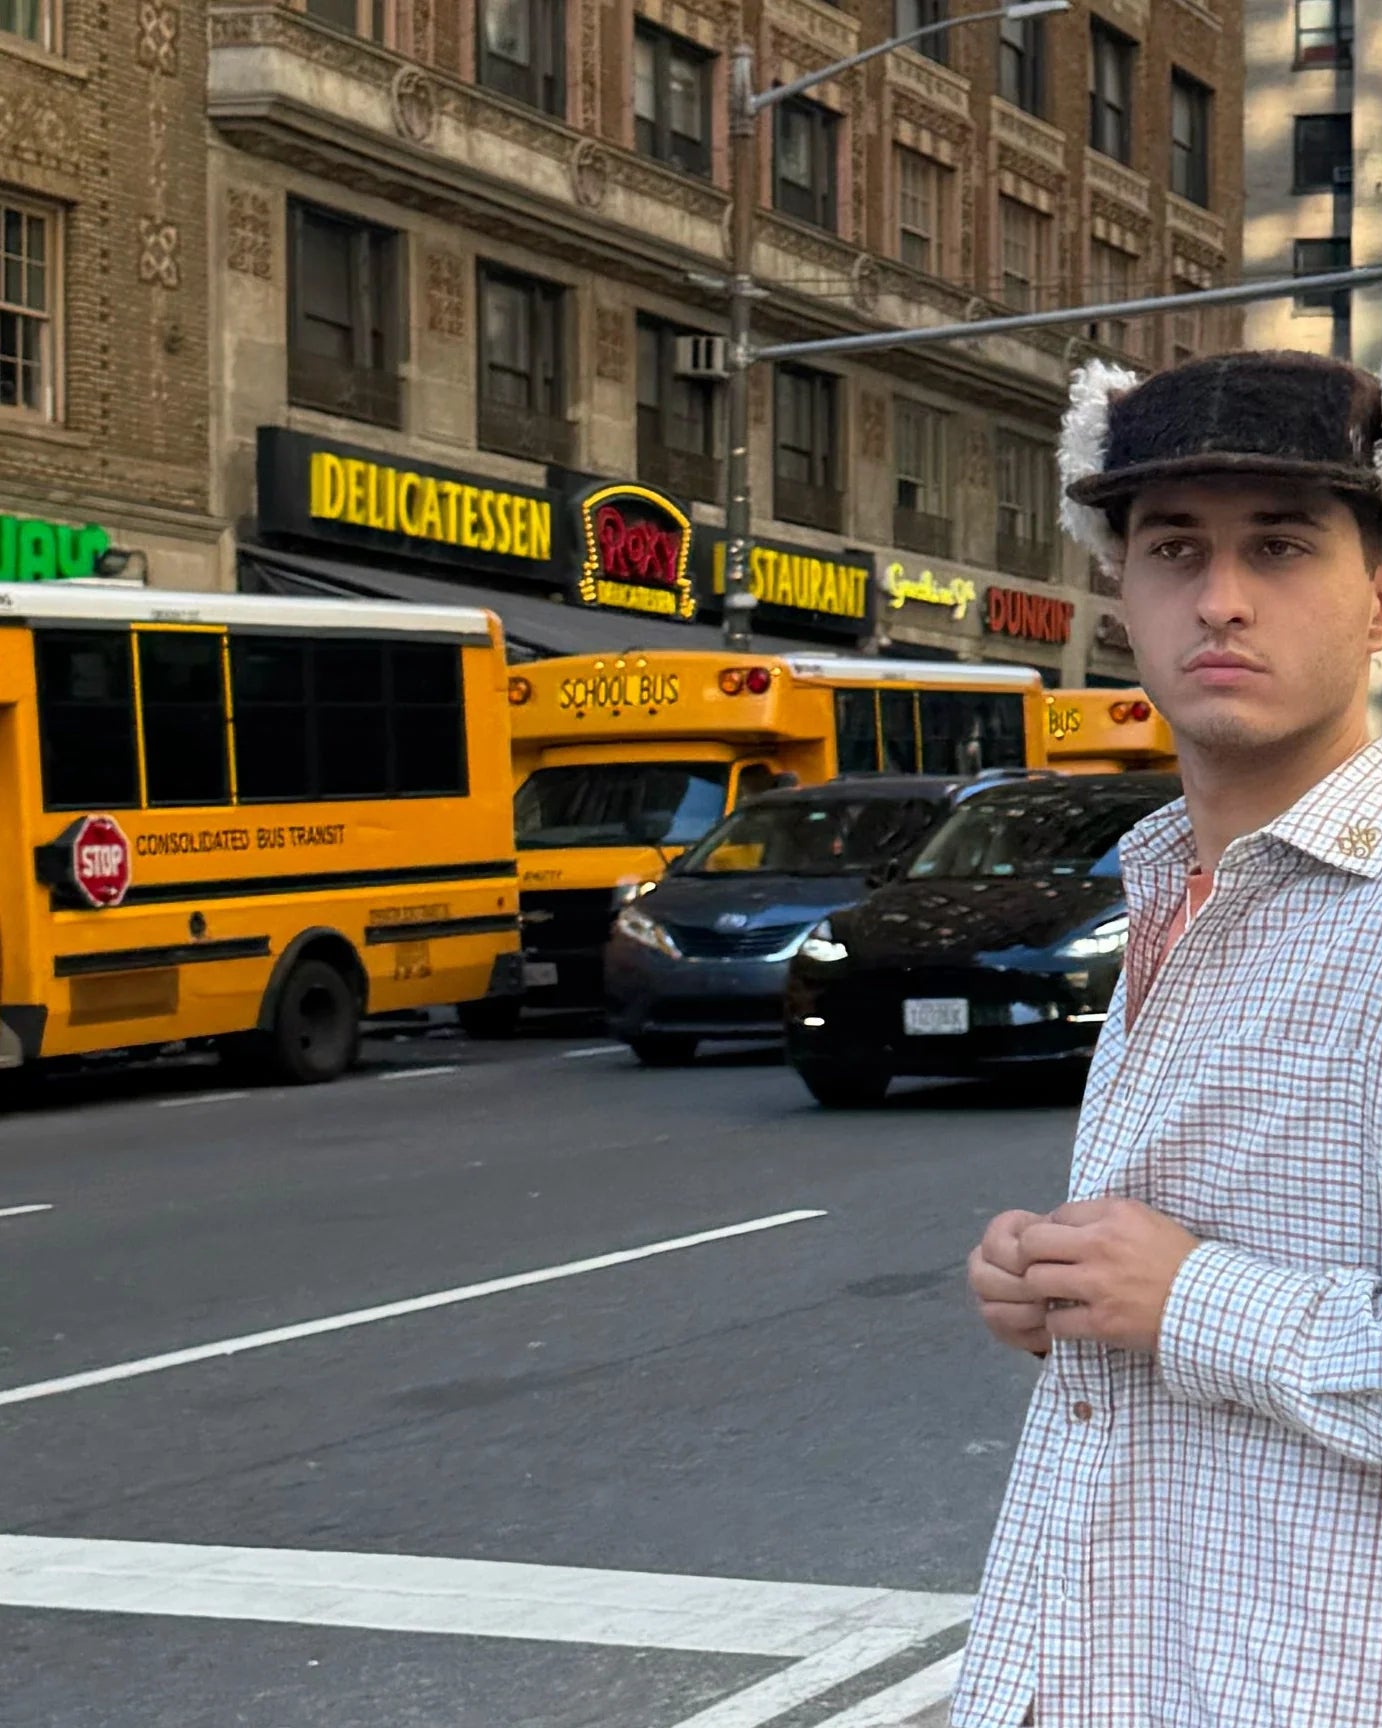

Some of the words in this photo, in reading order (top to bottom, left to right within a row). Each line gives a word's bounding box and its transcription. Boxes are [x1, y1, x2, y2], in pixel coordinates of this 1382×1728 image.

[311, 452, 551, 561] DELICATESSEN
[0, 514, 109, 581] AY
[713, 541, 868, 618] STAURANT
[560, 676, 633, 709] SCHOOL
[640, 673, 679, 705] BUS
[1047, 706, 1081, 736] BUS
[136, 829, 249, 856] CONSOLIDATED
[256, 828, 286, 849] BUS
[289, 824, 345, 846] TRANSIT
[81, 845, 123, 878] STOP
